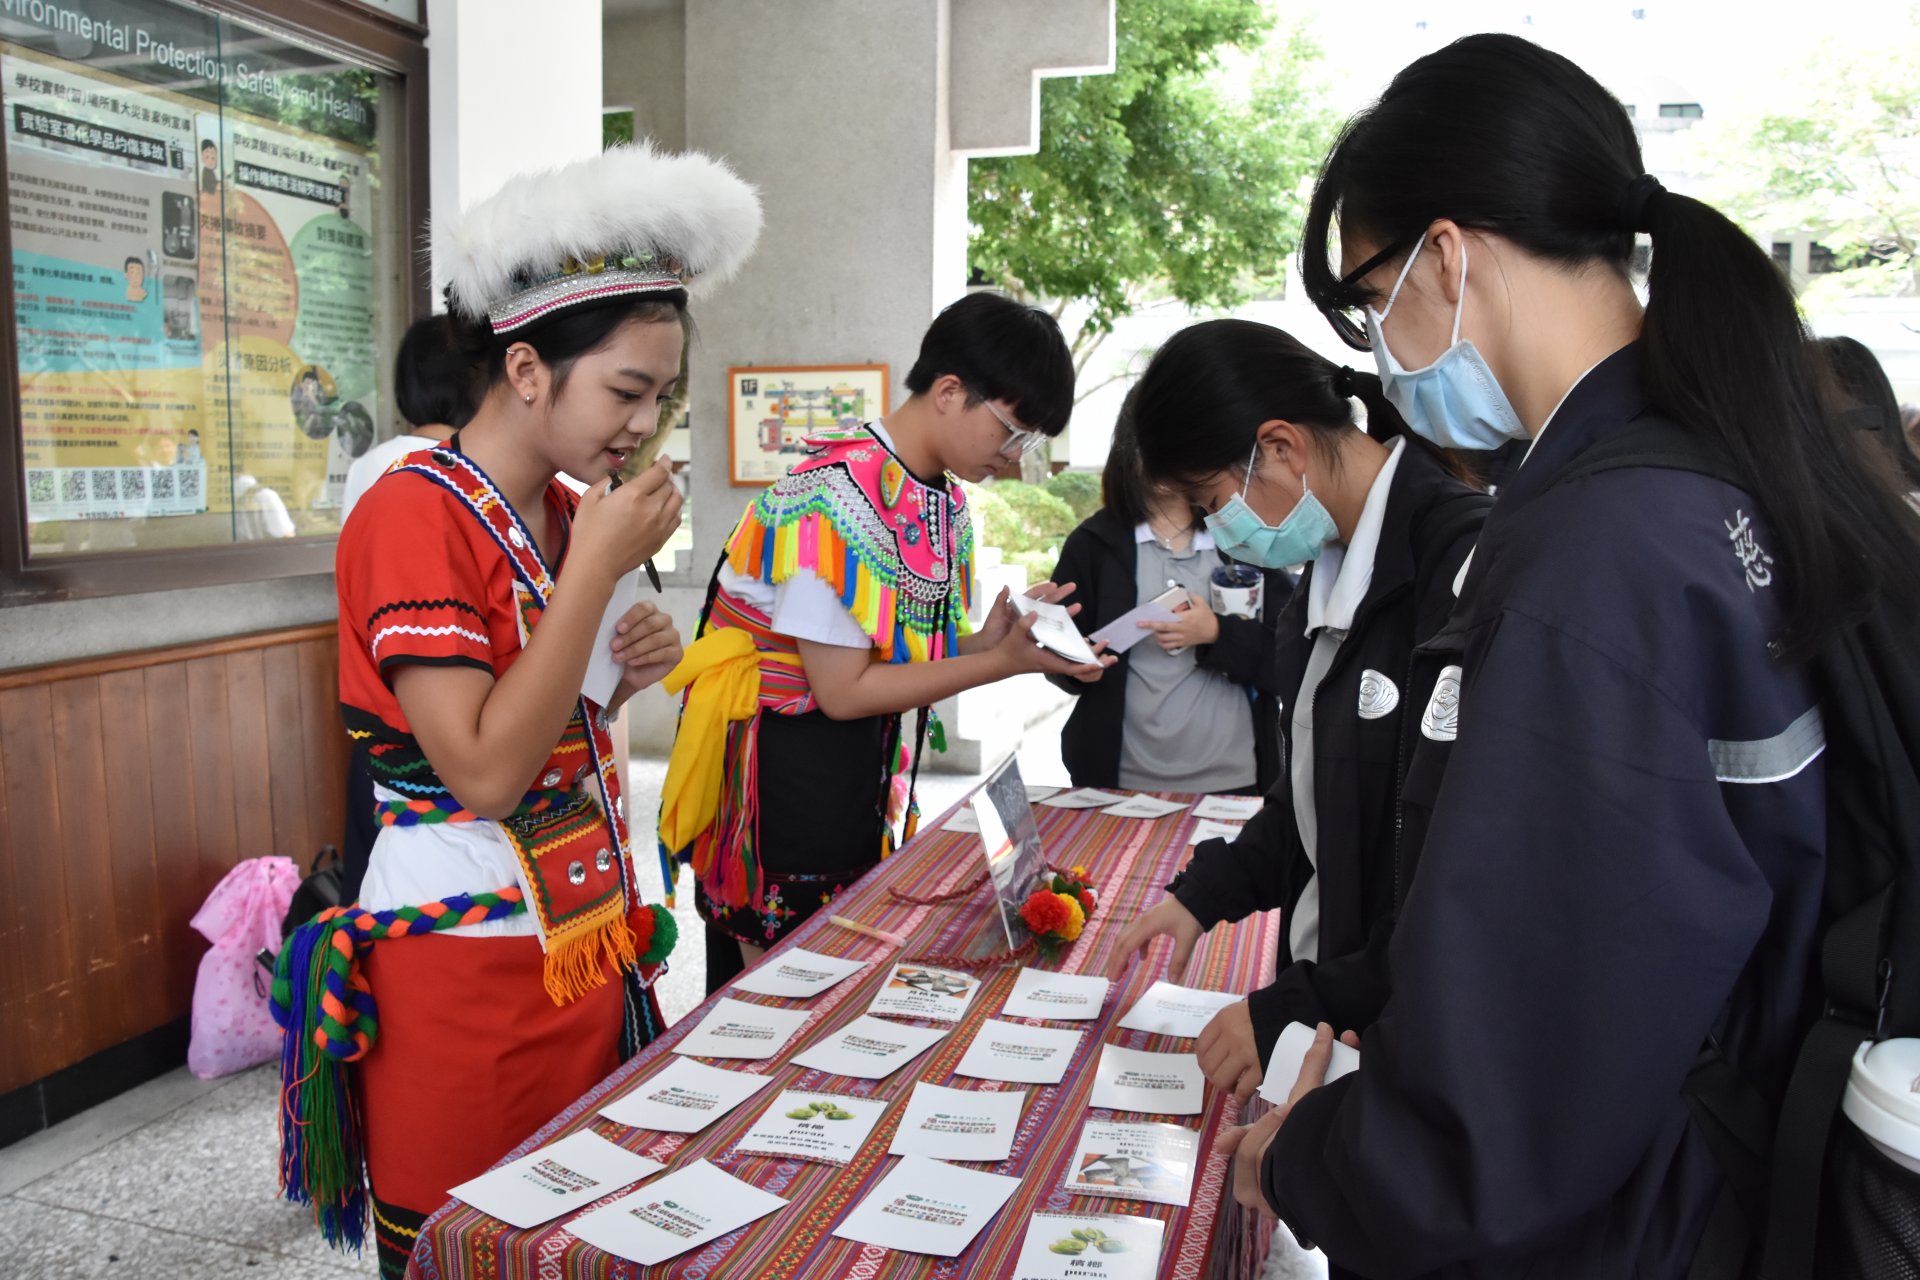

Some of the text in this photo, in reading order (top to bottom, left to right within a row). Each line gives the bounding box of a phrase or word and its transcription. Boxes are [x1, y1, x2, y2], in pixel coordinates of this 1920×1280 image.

[237, 63, 287, 106] Safety
[290, 86, 318, 111] and
[322, 90, 367, 124] Health
[742, 379, 758, 393] 1F
